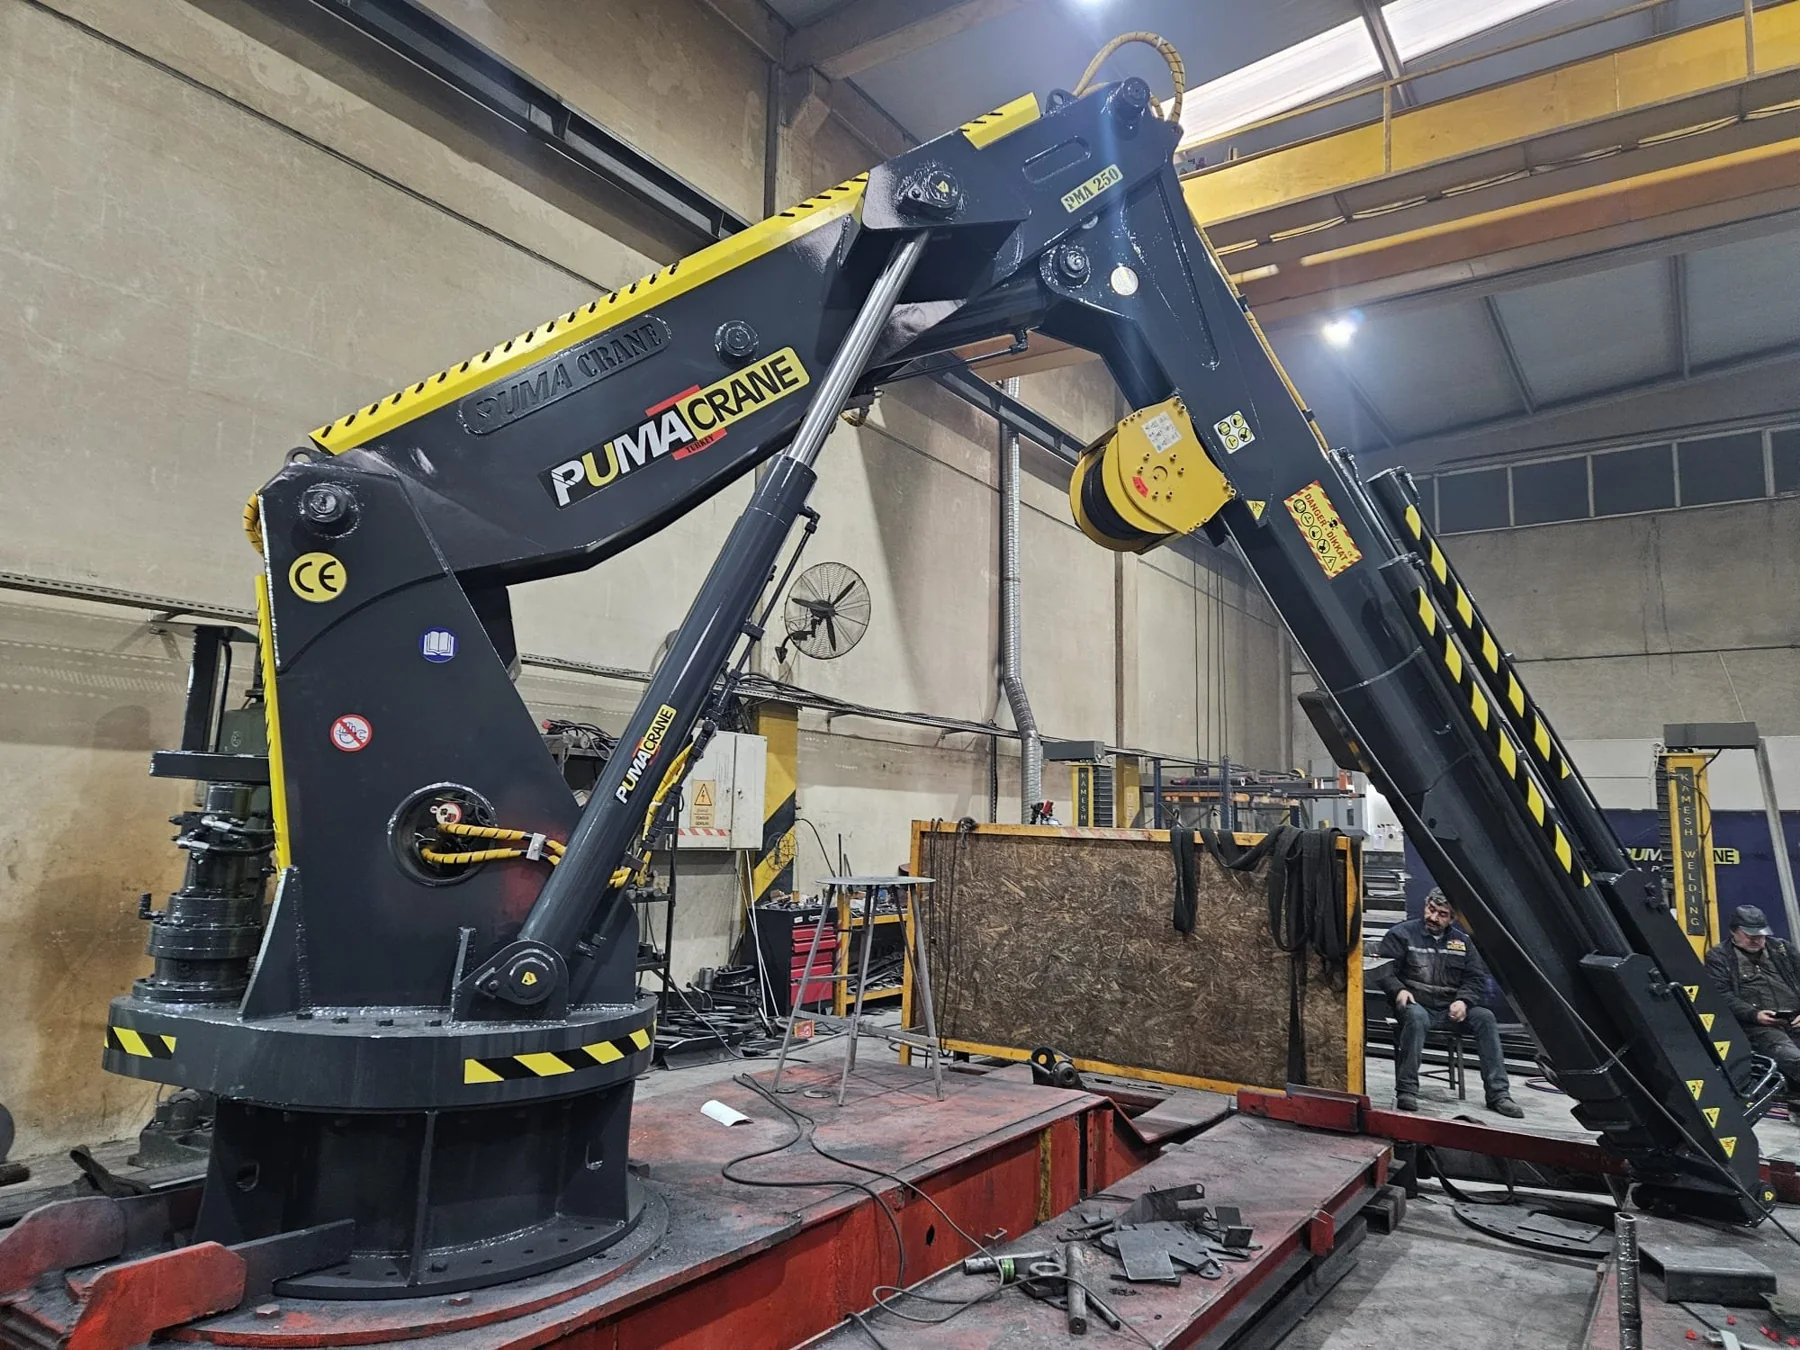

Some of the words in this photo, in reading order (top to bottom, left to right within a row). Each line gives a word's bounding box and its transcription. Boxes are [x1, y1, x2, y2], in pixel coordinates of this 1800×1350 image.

[1064, 185, 1094, 210] PMA
[1093, 168, 1119, 191] 250
[576, 323, 663, 378] CRANE
[686, 434, 714, 454] TURKEY
[1304, 493, 1328, 528] DANGER
[1680, 773, 1694, 836] KAMESH
[1683, 850, 1700, 926] WELDING
